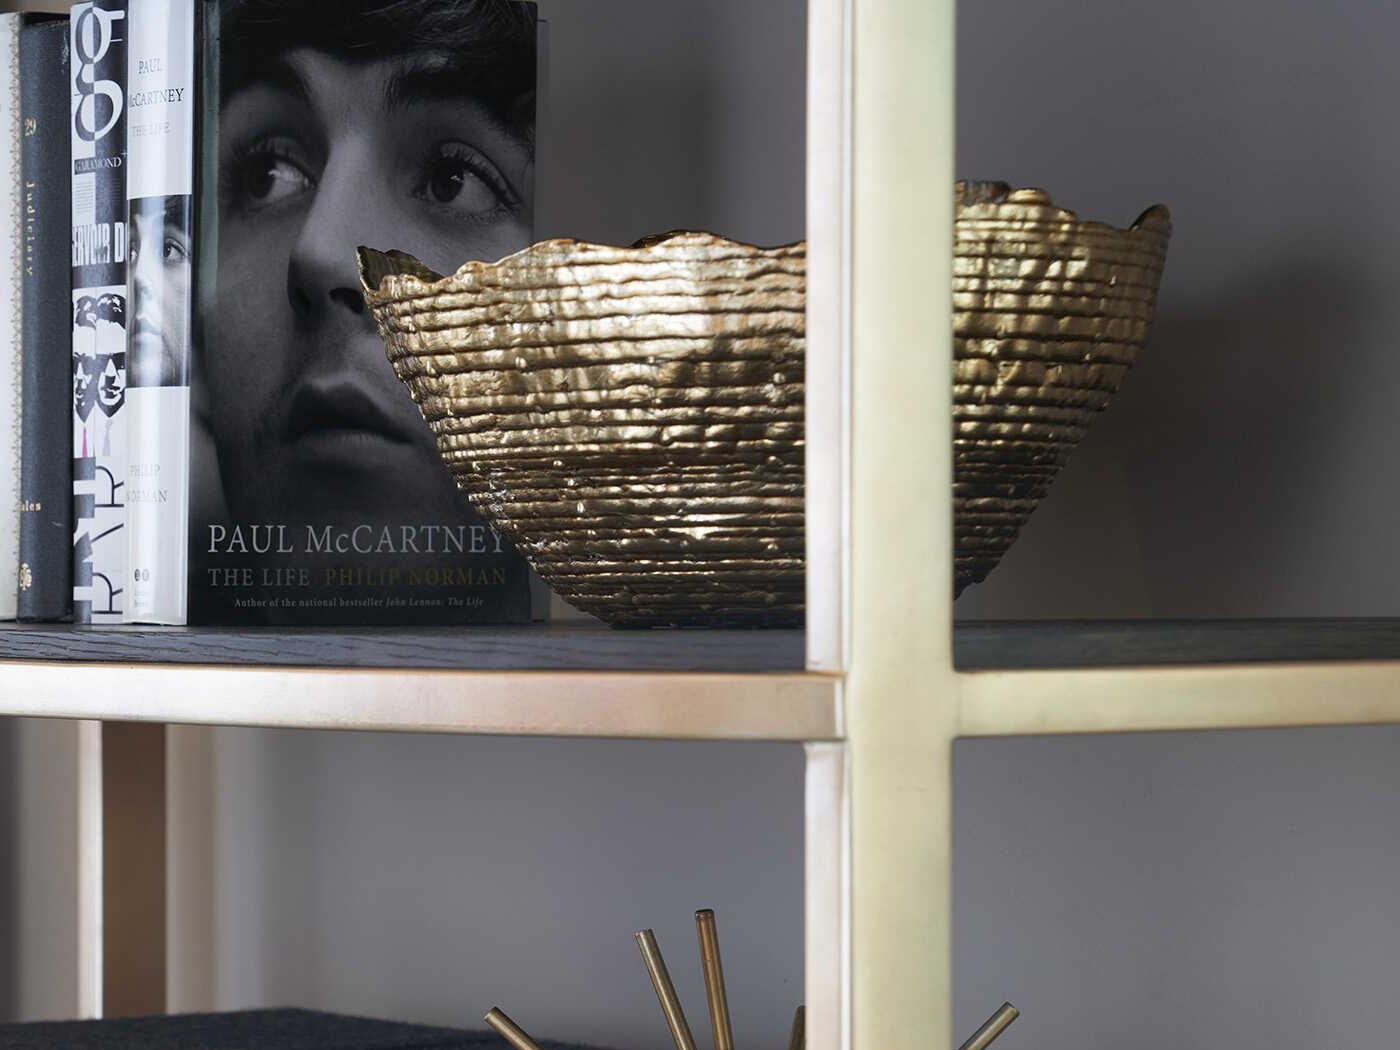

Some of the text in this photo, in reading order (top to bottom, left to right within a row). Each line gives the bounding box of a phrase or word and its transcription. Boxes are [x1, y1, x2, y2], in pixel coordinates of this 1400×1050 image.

[137, 58, 163, 74] PAUL
[25, 182, 36, 277] Judiciary
[72, 222, 111, 268] ERVOIR
[207, 523, 504, 553] PAUL McCARTNEY
[207, 567, 506, 587] THE LIFE PHILIP NORMAN
[234, 597, 267, 608] Author
[269, 597, 280, 608] of
[282, 597, 297, 607] the
[299, 597, 337, 607] national
[339, 597, 384, 607] bestseller
[385, 597, 406, 608] John
[447, 597, 464, 606] The
[466, 596, 484, 608] Life
